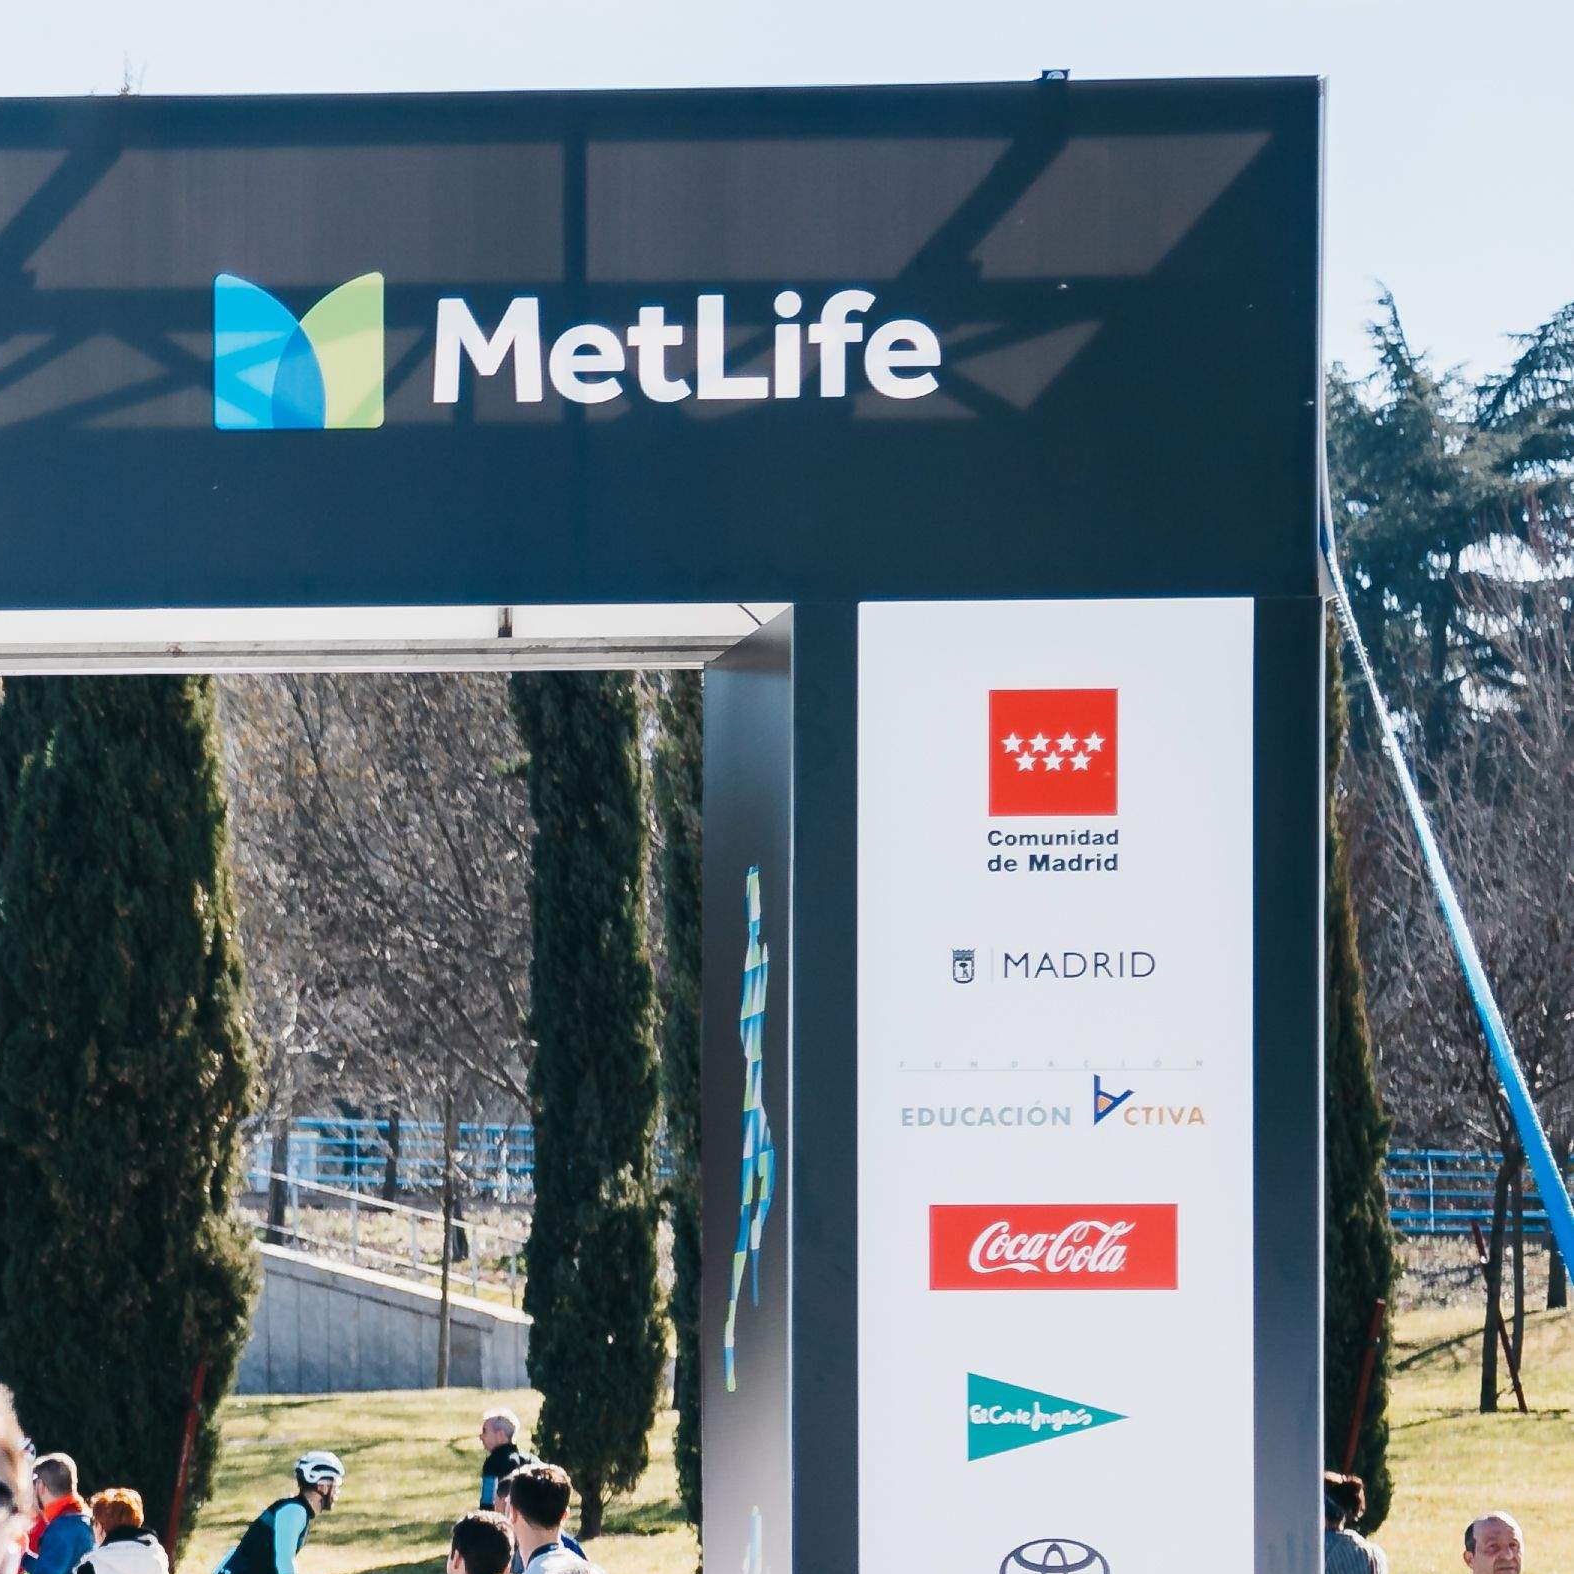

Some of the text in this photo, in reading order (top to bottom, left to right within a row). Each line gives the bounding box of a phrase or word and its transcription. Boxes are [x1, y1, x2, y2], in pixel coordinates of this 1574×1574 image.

[433, 289, 943, 403] MetLife
[987, 829, 1120, 847] Comunidad
[987, 854, 1119, 873] de Madrid
[1002, 951, 1156, 980] MADRID
[901, 1099, 1072, 1127] EDUCACIÓN
[968, 1219, 1136, 1274] Coca-Cola
[969, 1401, 1093, 1432] El Corte Inglés
